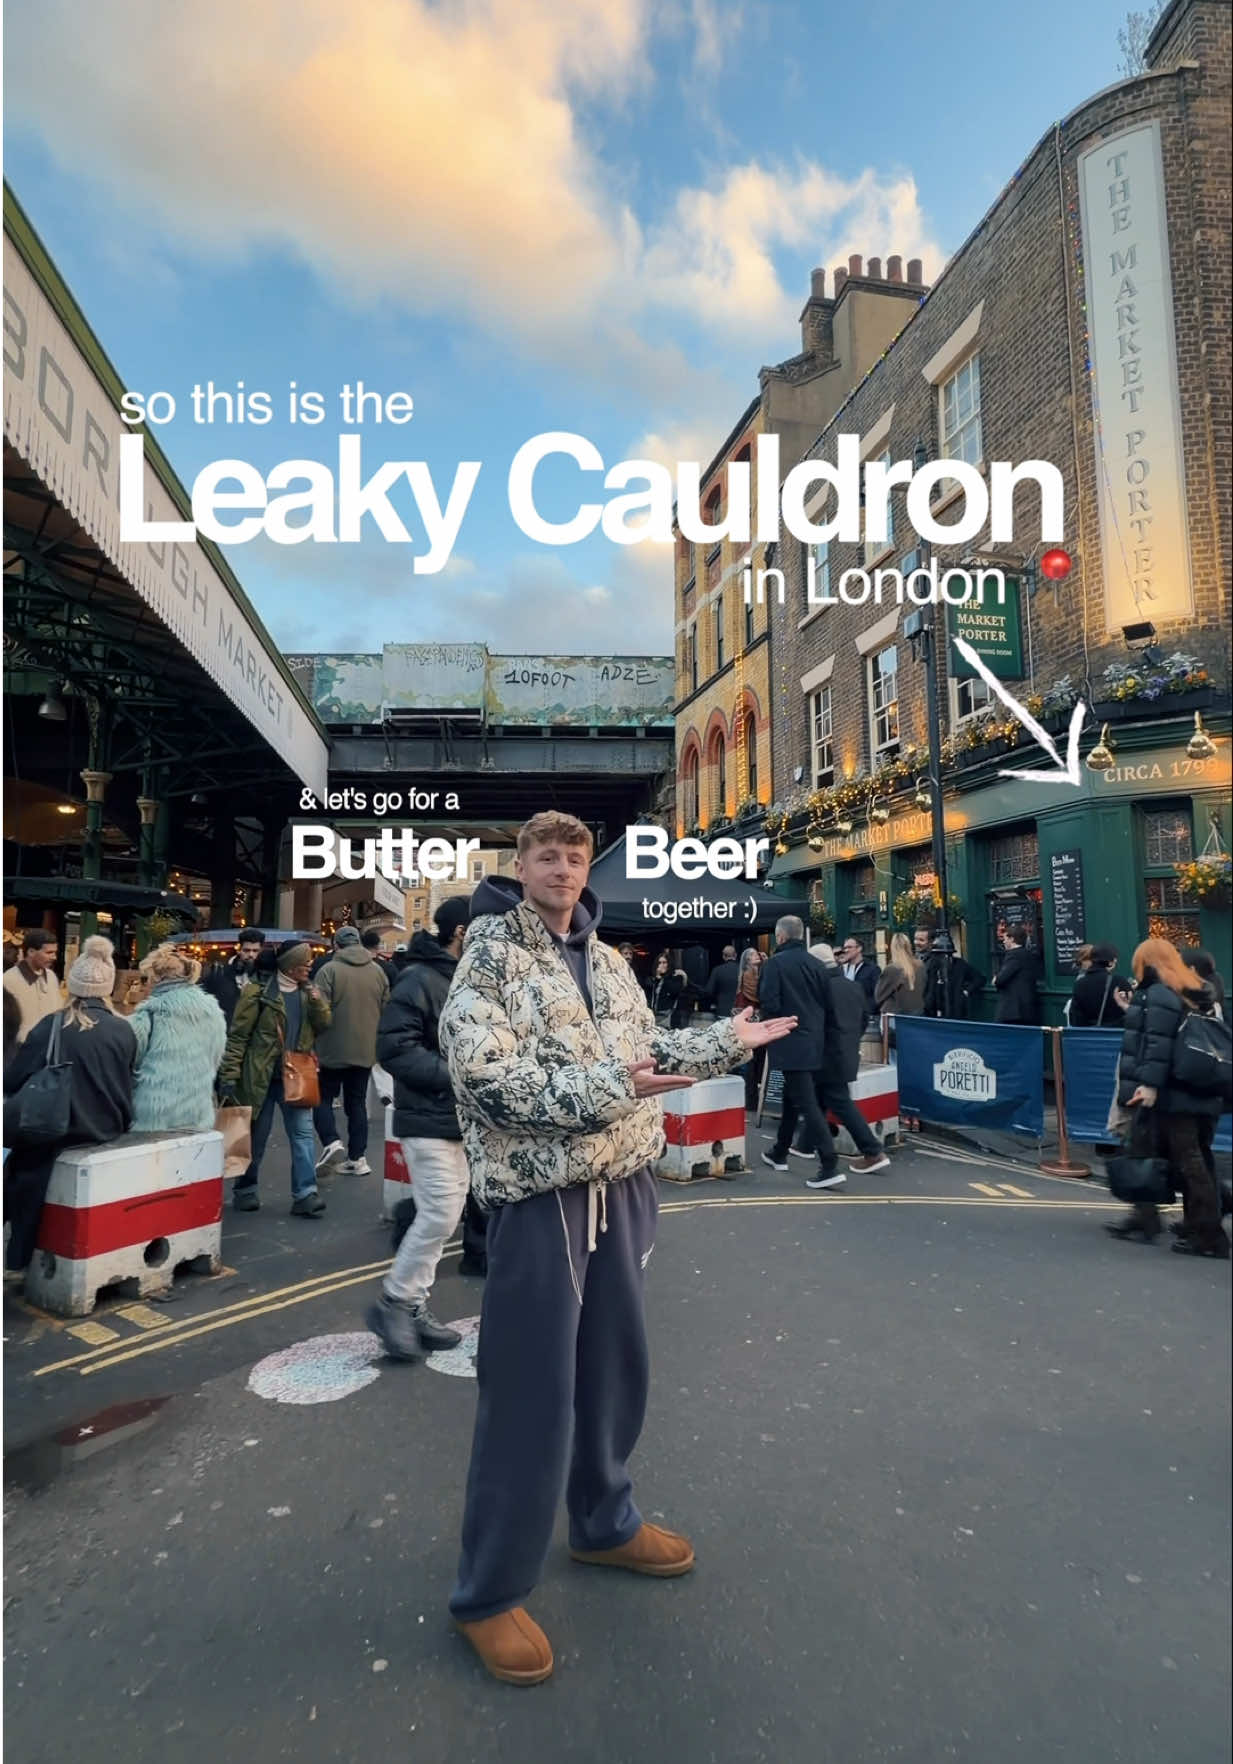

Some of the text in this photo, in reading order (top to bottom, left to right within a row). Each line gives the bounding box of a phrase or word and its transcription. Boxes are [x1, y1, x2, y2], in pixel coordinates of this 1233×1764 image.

[1106, 151, 1158, 606] THE MARKET PORTER
[3, 285, 283, 723] BORUGH MARKET
[957, 613, 1006, 627] MARKET
[958, 628, 1007, 642] PORTER
[504, 670, 576, 688] 10FOOT
[1104, 763, 1163, 783] CIRCA
[940, 1070, 989, 1094] PORETTI
